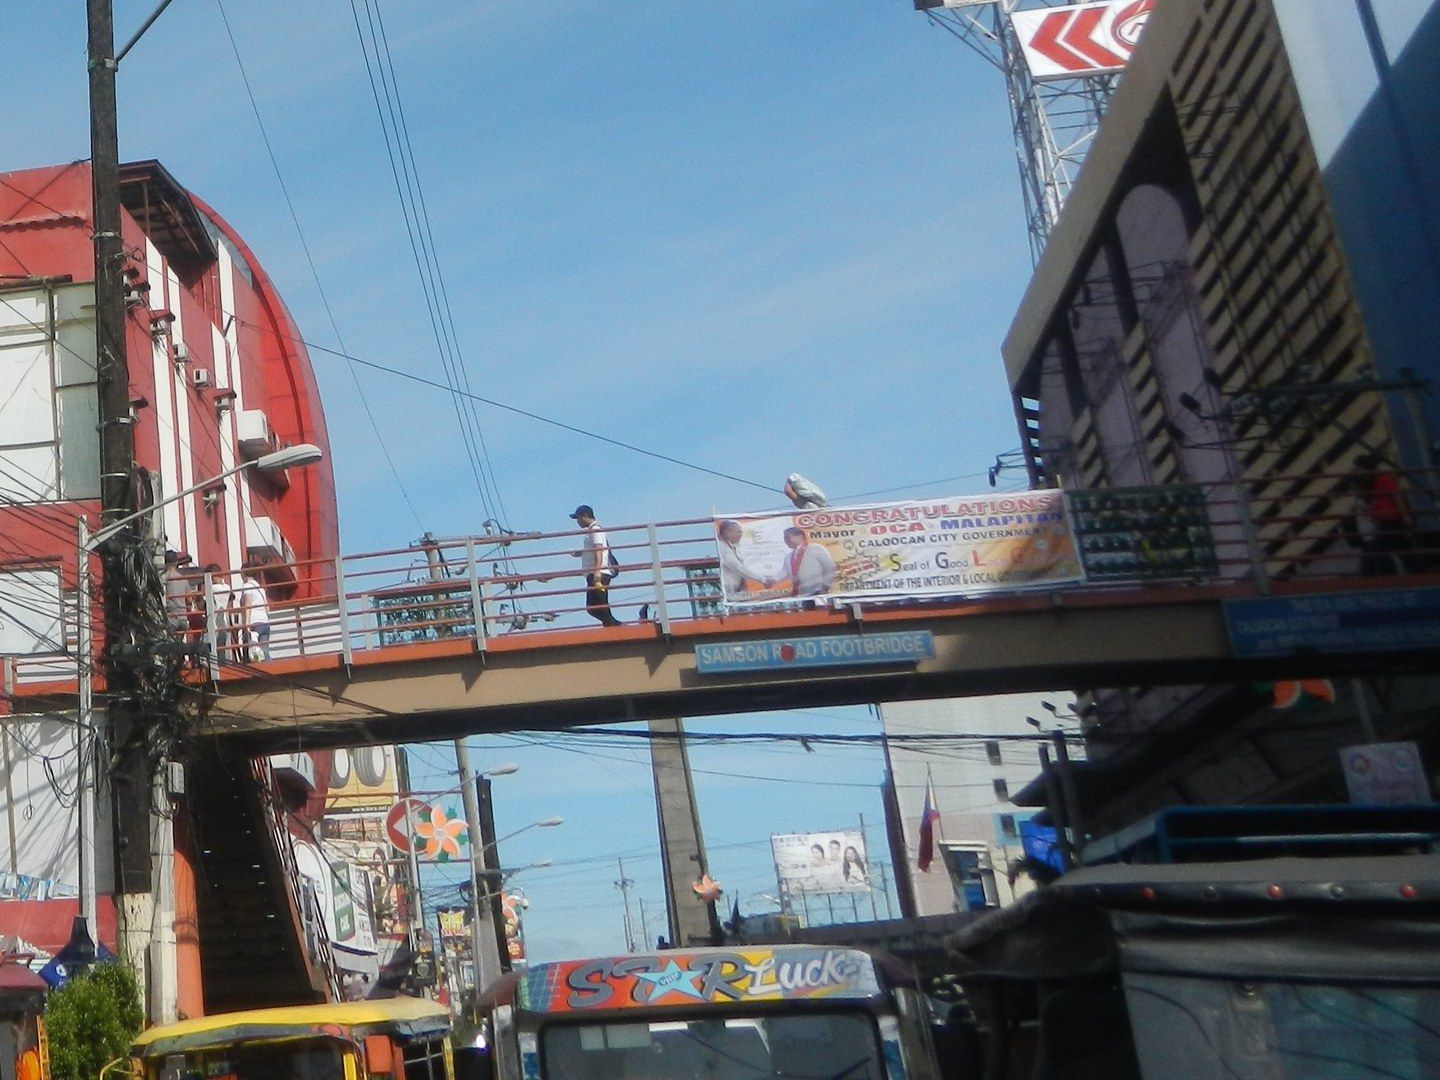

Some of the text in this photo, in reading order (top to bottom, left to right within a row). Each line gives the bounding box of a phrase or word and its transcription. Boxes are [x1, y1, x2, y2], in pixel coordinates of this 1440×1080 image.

[795, 496, 1058, 528] CONGRATULATIONS
[810, 529, 856, 540] Mayor
[858, 536, 926, 548] CALOOCAN
[930, 533, 957, 543] CITY
[889, 553, 917, 572] Seal
[920, 561, 930, 570] of
[935, 551, 969, 570] Good
[893, 578, 906, 589] OF
[907, 577, 922, 588] THE
[923, 575, 961, 587] INTERIOR
[701, 634, 924, 664] SAMSON RAD FOOTBRIDGE
